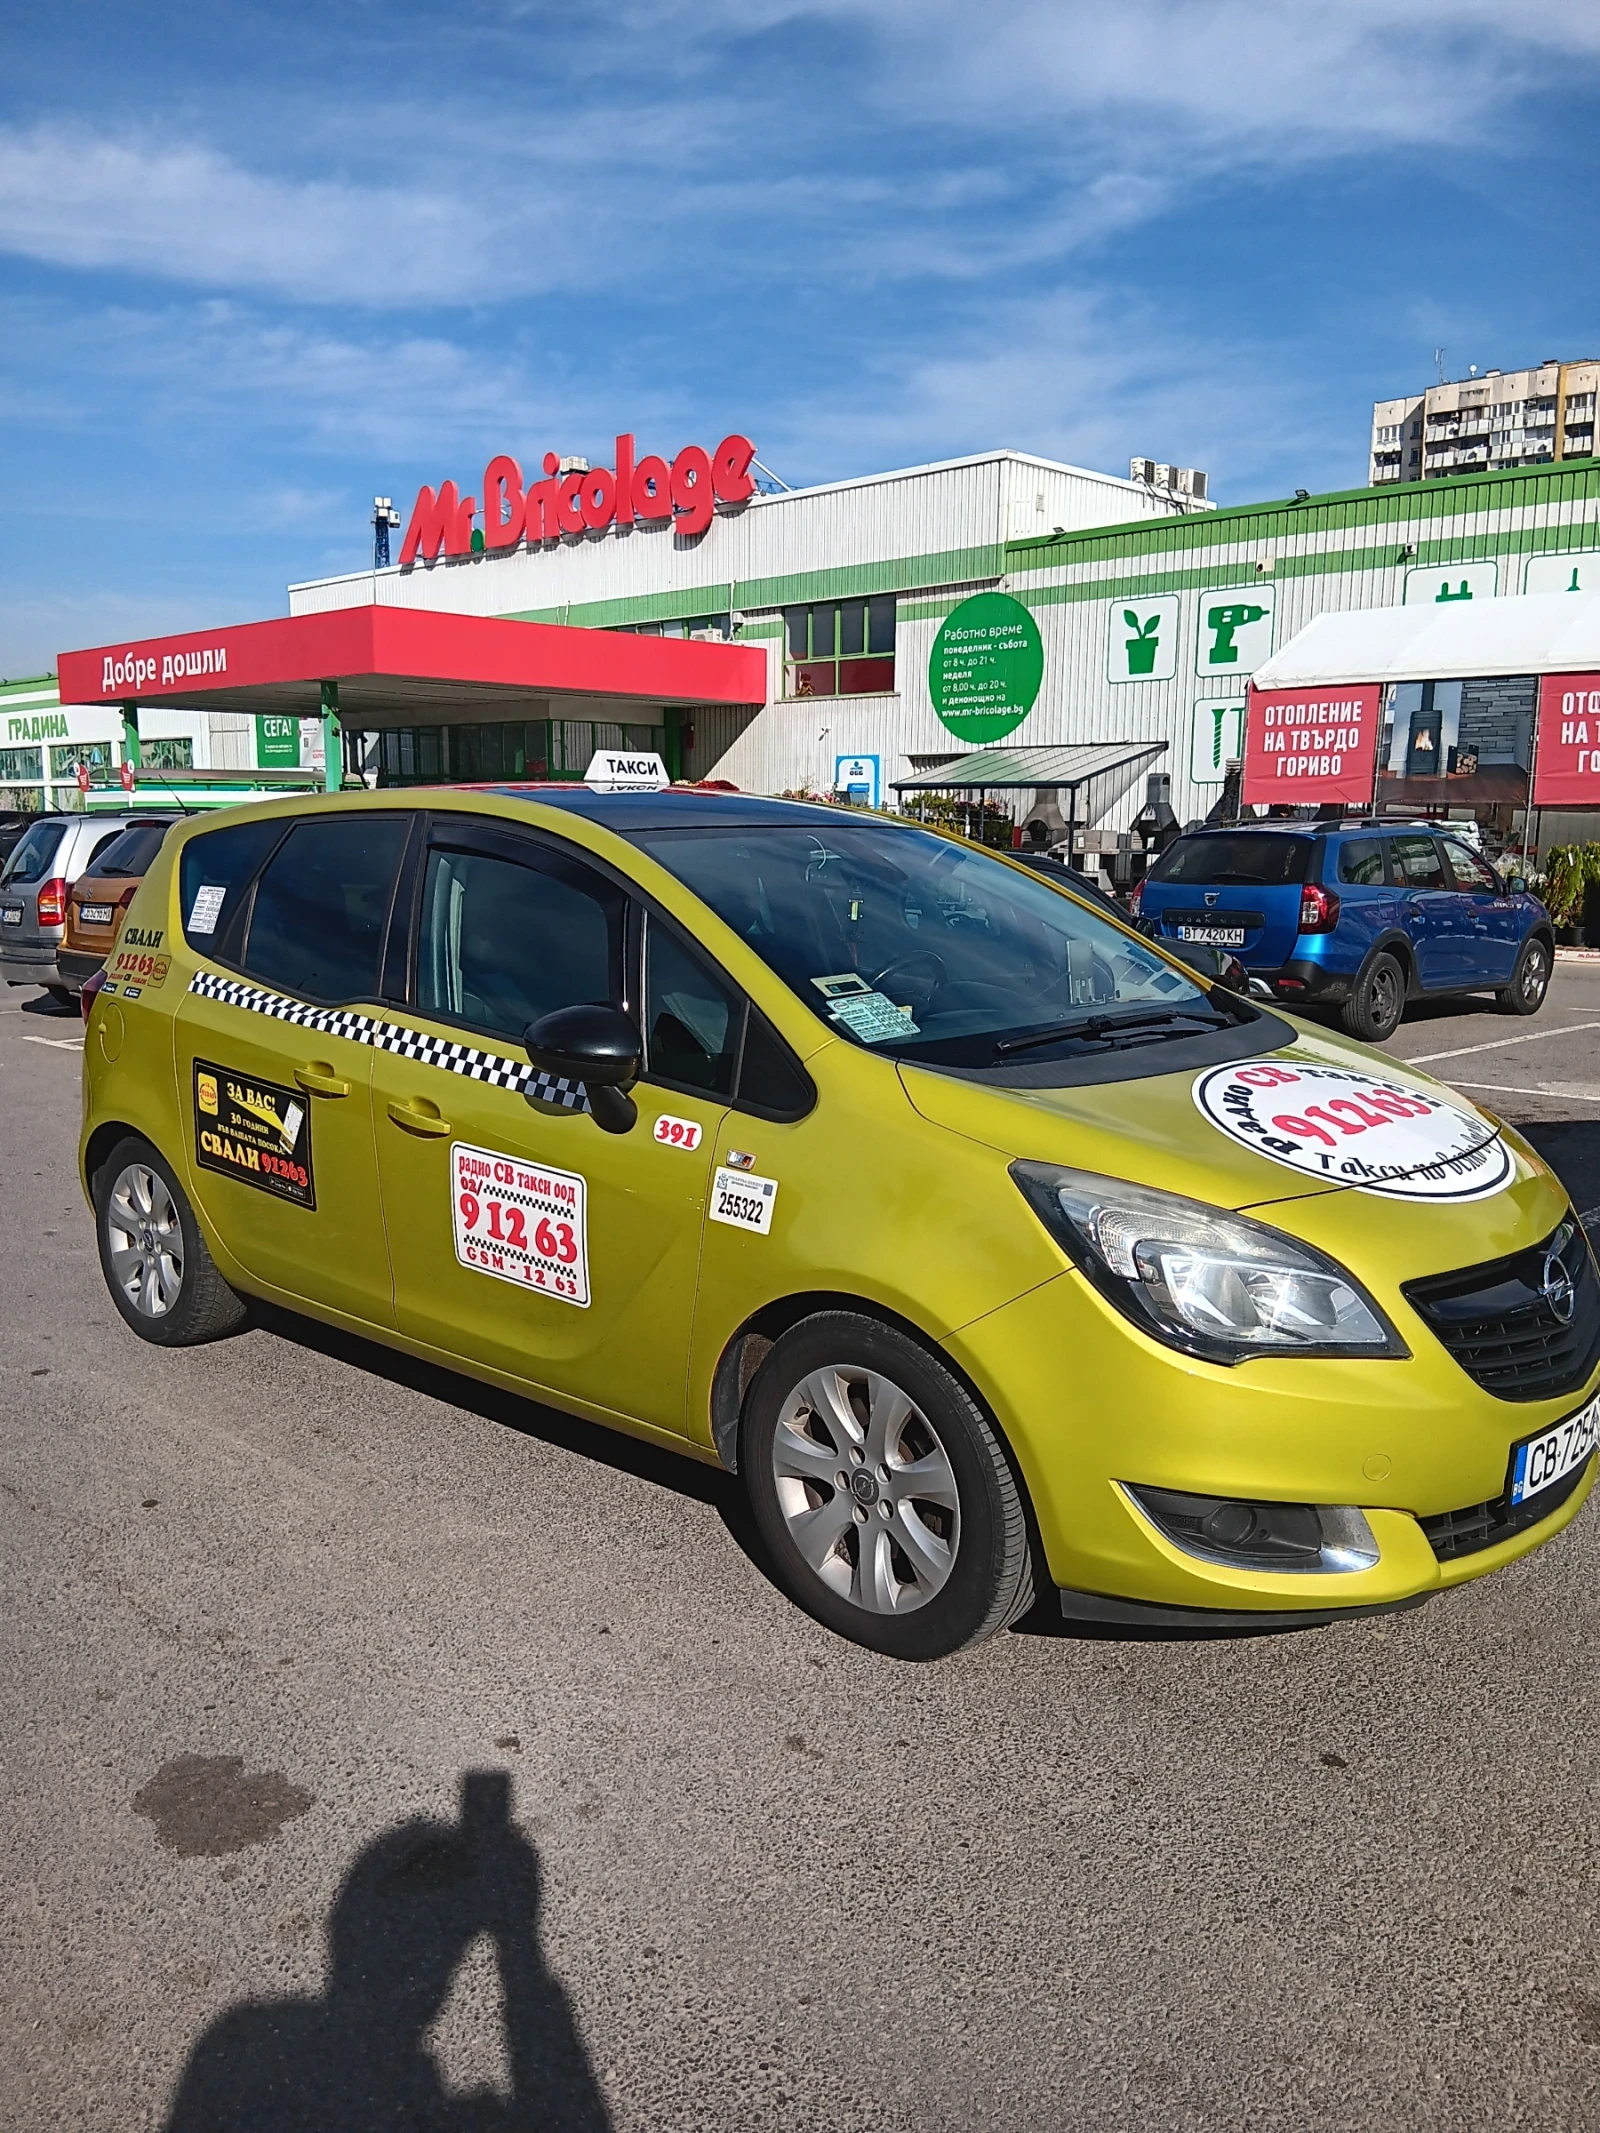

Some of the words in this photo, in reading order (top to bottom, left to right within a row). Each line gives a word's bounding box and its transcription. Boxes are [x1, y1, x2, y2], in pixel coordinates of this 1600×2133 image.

[944, 627, 987, 641] Работно
[989, 624, 1022, 639] време
[943, 643, 992, 655] понеделник
[998, 639, 1027, 650] събота
[102, 651, 156, 693] Добре
[162, 648, 227, 685] дошли
[979, 656, 988, 665] 21
[943, 671, 972, 680] неделя
[989, 679, 999, 689] 20
[1264, 700, 1363, 727] ОТОПЛЕНИЕ
[7, 713, 69, 742] ГРАДИНА
[263, 719, 292, 738] СЕГА!
[1561, 721, 1588, 744] НА
[1263, 731, 1285, 752] НА
[1290, 727, 1359, 753] ТВЪРДО
[606, 759, 658, 775] ТАКСИ
[1276, 755, 1341, 777] ГОРИВО
[124, 928, 164, 948] СВАЛИ
[114, 953, 154, 976] 91263
[1235, 1066, 1301, 1088] СВ
[226, 1082, 243, 1101] ЗА
[246, 1088, 276, 1112] ВАС!
[230, 1112, 242, 1124] 30
[1272, 1089, 1432, 1147] 91263
[656, 1120, 697, 1148] 391
[201, 1130, 260, 1172] СВАЛИ
[261, 1152, 308, 1187] 91263
[459, 1156, 491, 1179] радио
[494, 1162, 514, 1185] СВ
[517, 1172, 552, 1197] такси
[554, 1183, 576, 1208] оод
[718, 1192, 763, 1224] 255322
